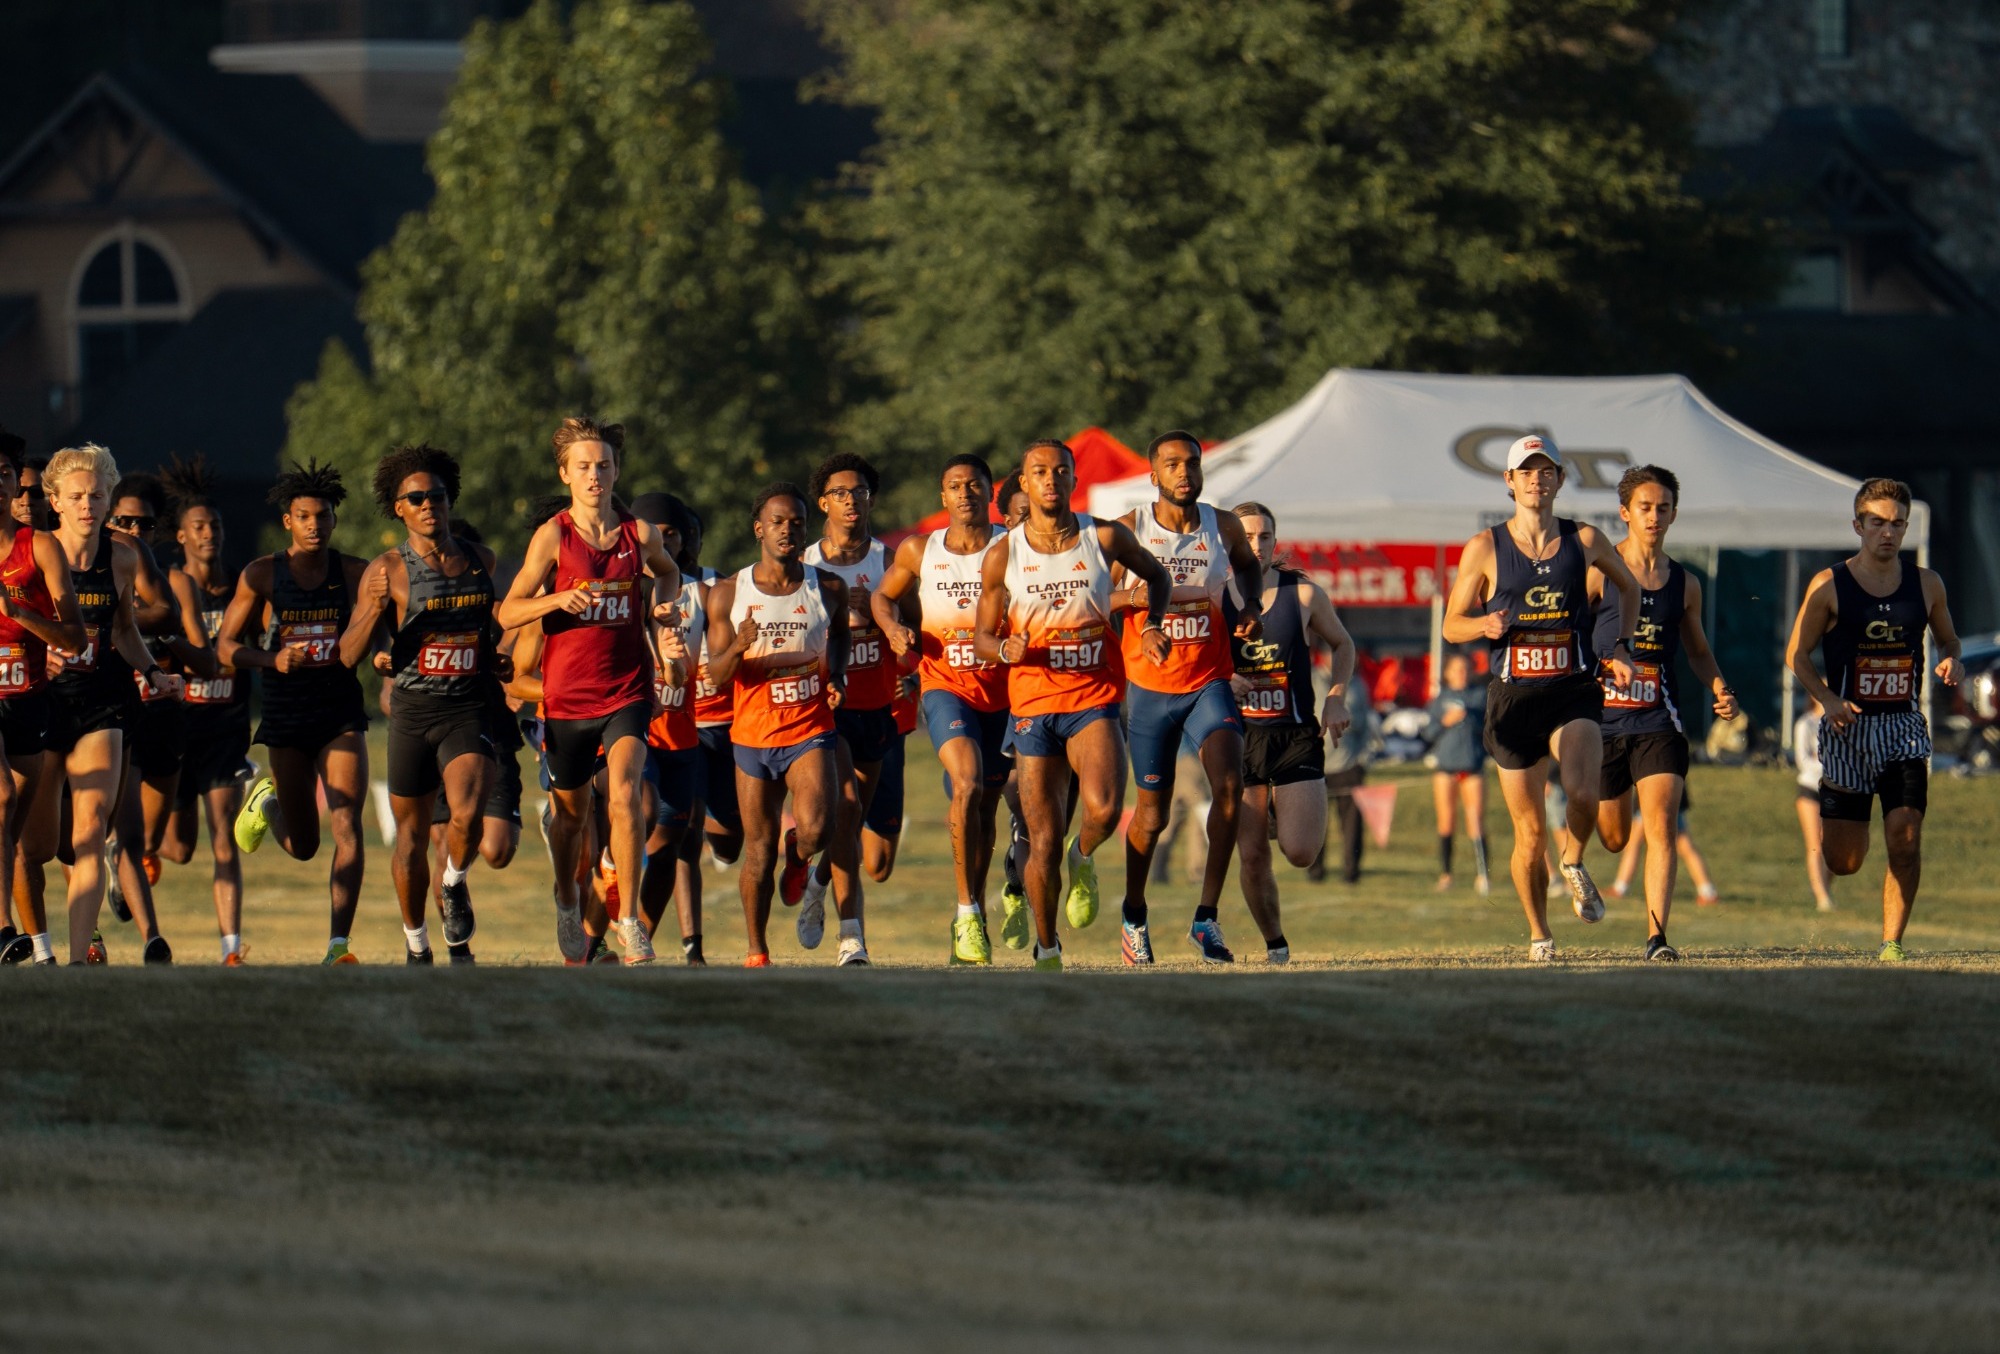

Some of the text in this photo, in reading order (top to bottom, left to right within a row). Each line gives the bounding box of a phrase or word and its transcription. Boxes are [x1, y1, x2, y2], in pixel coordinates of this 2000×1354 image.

[936, 581, 982, 591] CLAYTO
[1027, 579, 1090, 594] CLAYTON
[1040, 590, 1077, 600] STATE
[1311, 567, 1407, 601] RACK
[76, 593, 111, 606] HORPE
[427, 593, 488, 611] OGLETHORPE
[1525, 585, 1564, 610] GT
[757, 621, 808, 631] LAYTON
[1162, 615, 1211, 640] 5602
[1518, 613, 1537, 621] CLUB
[761, 630, 795, 638] STATE
[1865, 620, 1903, 642] GT
[424, 647, 475, 670] 5740
[947, 644, 986, 668] 55
[1049, 640, 1103, 669] 5597
[1241, 639, 1279, 662] GT
[1517, 647, 1568, 671] 5810
[770, 674, 820, 704] 5596
[1859, 672, 1910, 696] 5785
